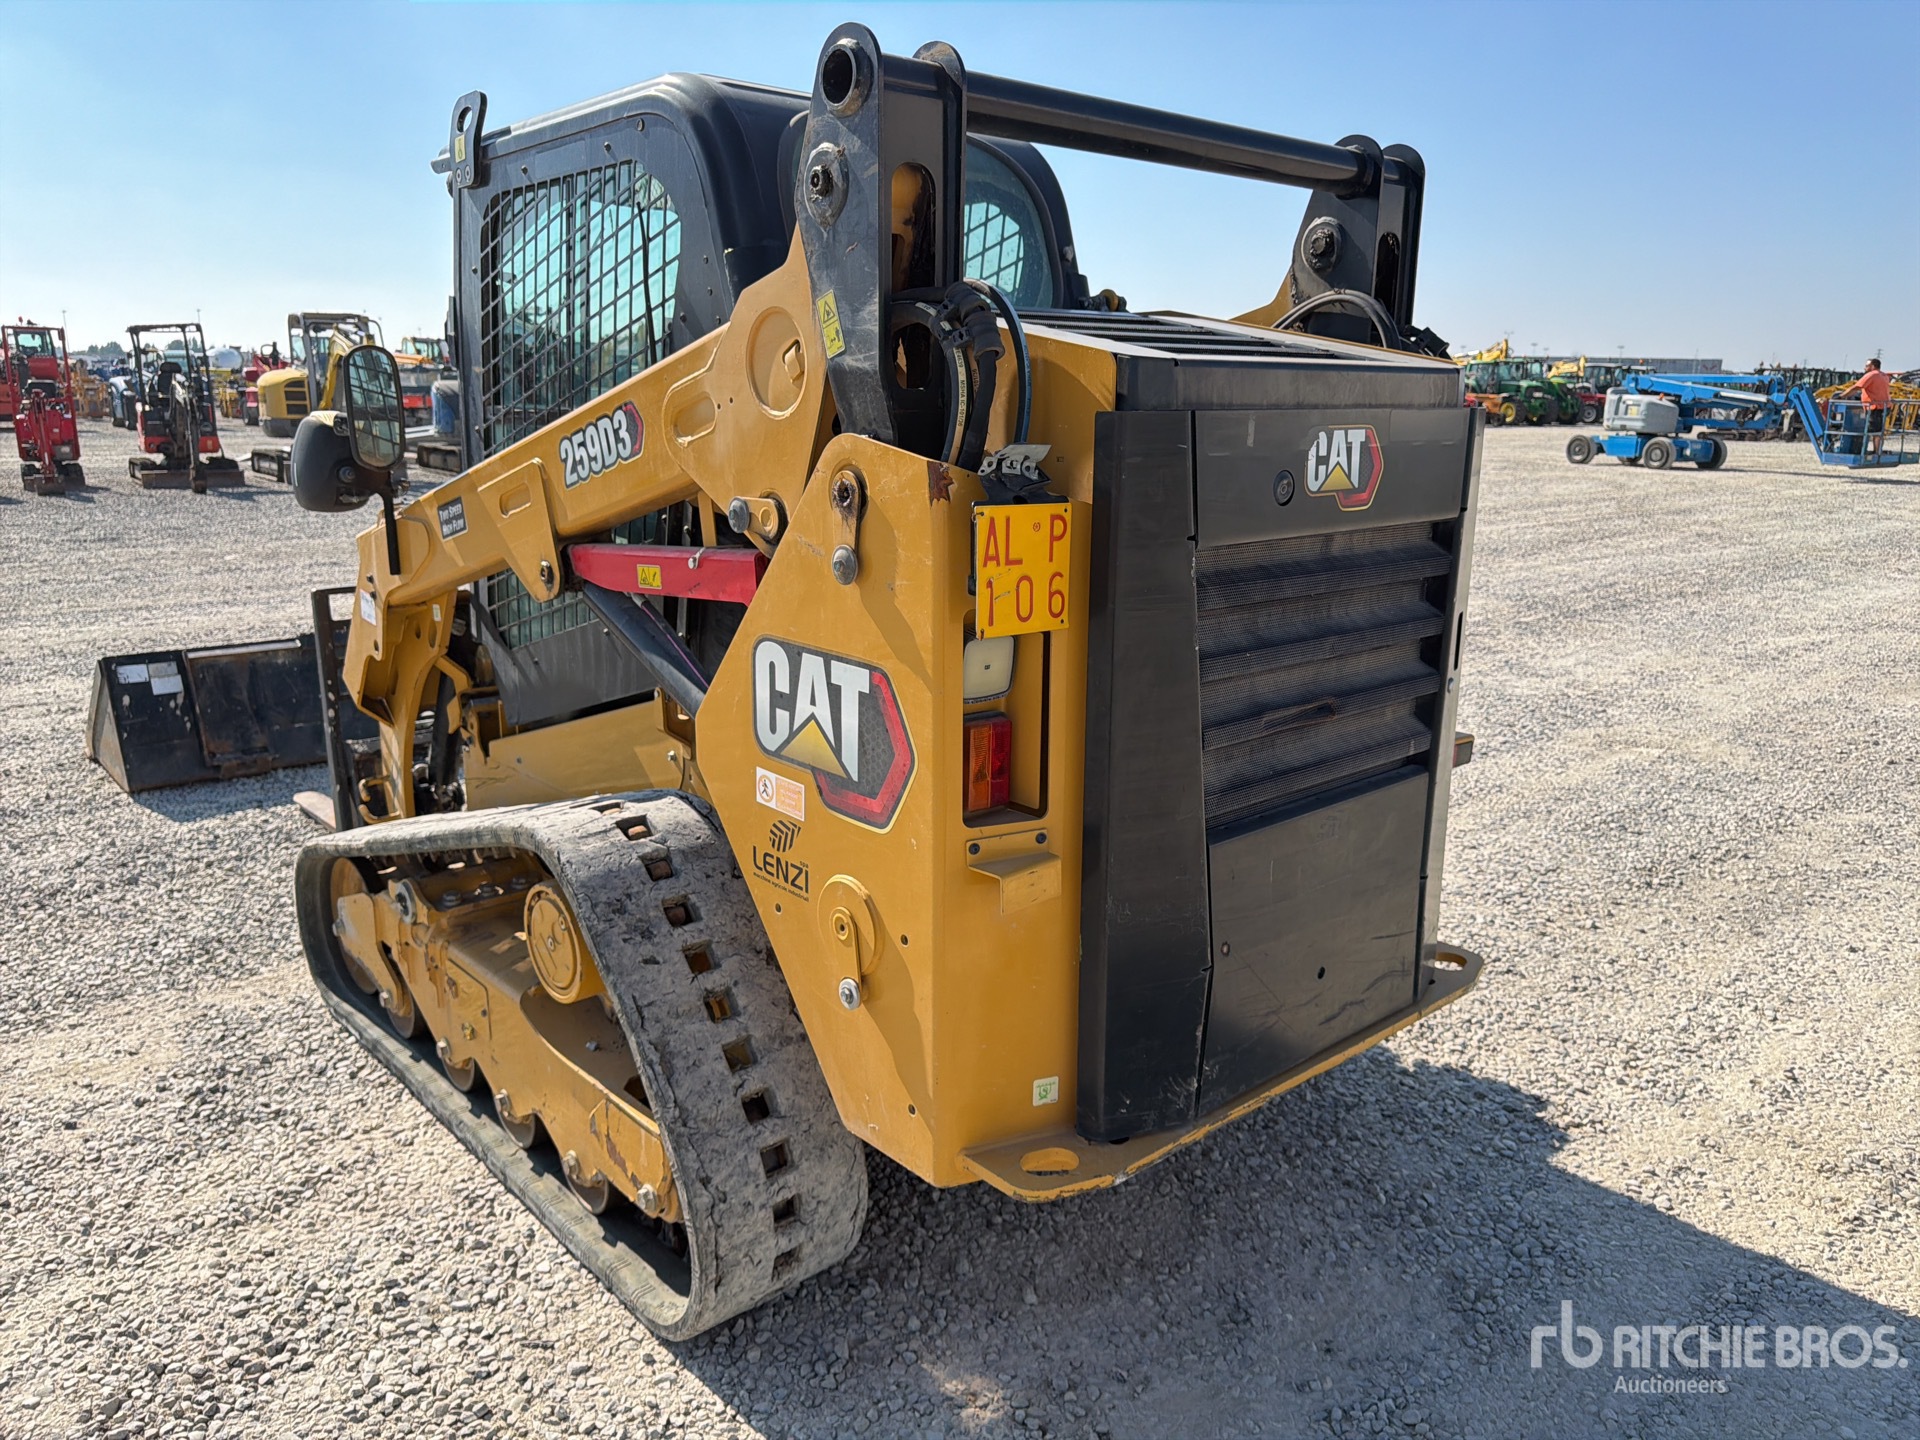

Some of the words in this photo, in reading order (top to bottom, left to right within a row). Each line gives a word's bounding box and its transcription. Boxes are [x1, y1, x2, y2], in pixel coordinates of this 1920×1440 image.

[560, 409, 632, 486] 259D3
[1307, 429, 1366, 492] CAT
[983, 515, 1024, 568] AL
[1048, 513, 1068, 563] P
[986, 571, 1066, 628] 106
[755, 640, 870, 783] CAT
[753, 845, 809, 894] LENZI
